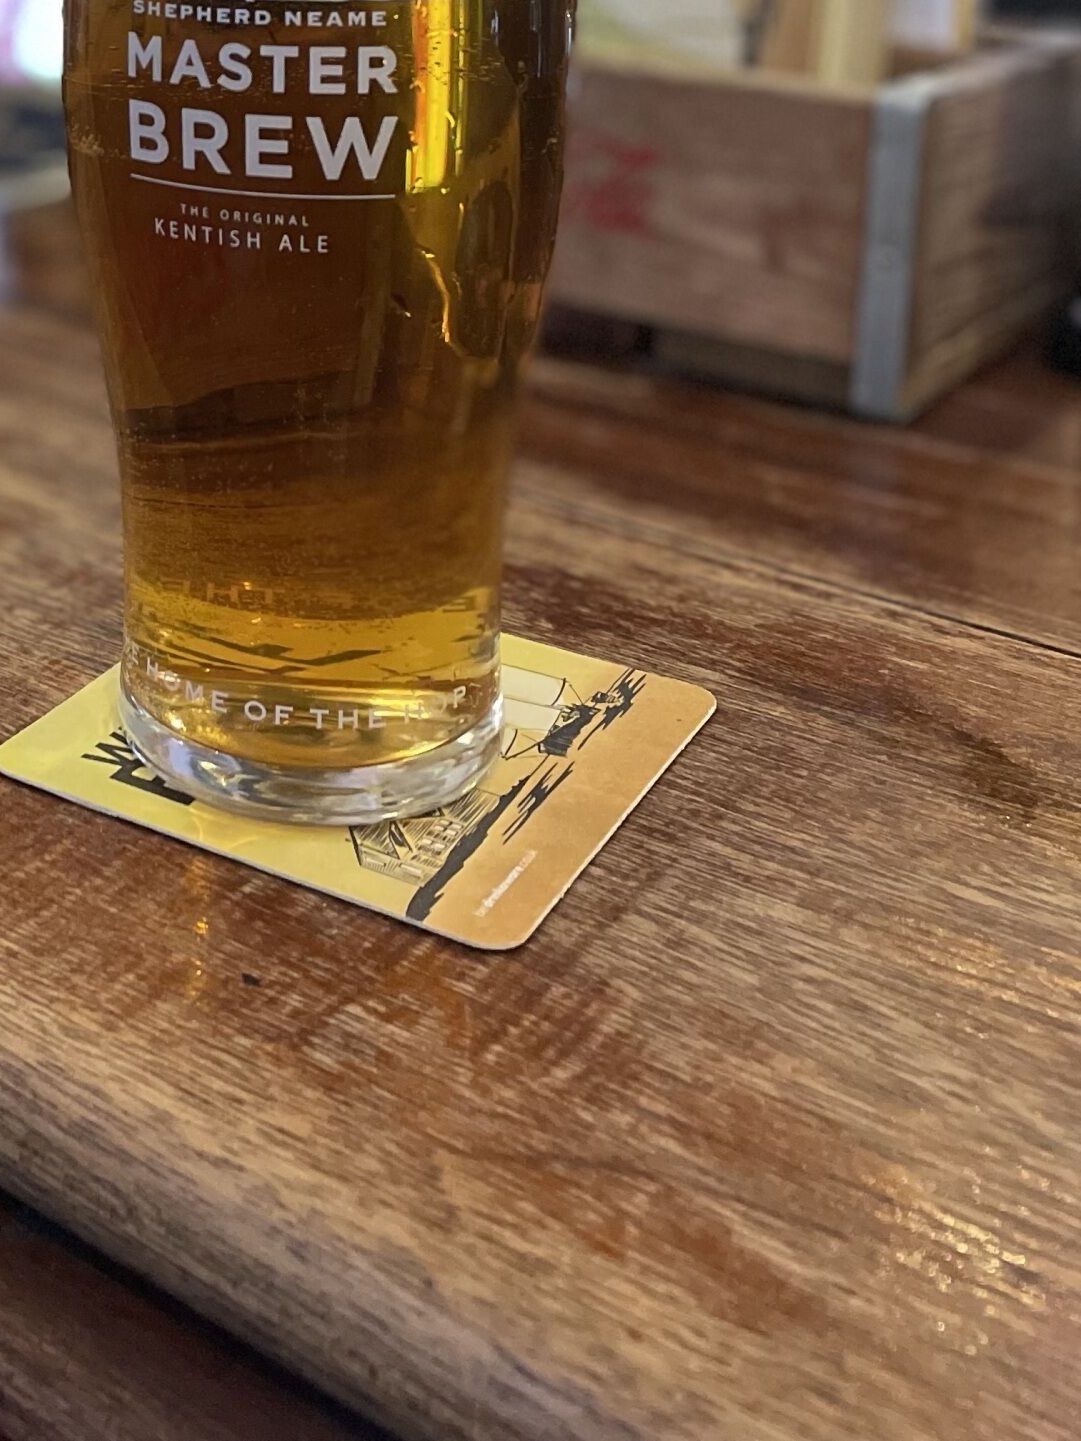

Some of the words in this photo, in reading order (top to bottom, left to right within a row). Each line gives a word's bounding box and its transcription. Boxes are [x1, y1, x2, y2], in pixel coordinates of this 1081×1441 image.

[133, 0, 271, 25] SHEPHERD
[284, 11, 387, 27] NEAME
[128, 31, 398, 94] MASTER
[129, 99, 398, 181] BREW
[154, 217, 261, 249] KENTISH
[278, 234, 329, 253] ALE
[180, 203, 209, 218] THE
[220, 209, 309, 227] ORIGINAL
[146, 657, 228, 713] HOME
[244, 700, 293, 725] OF
[310, 708, 386, 730] THE
